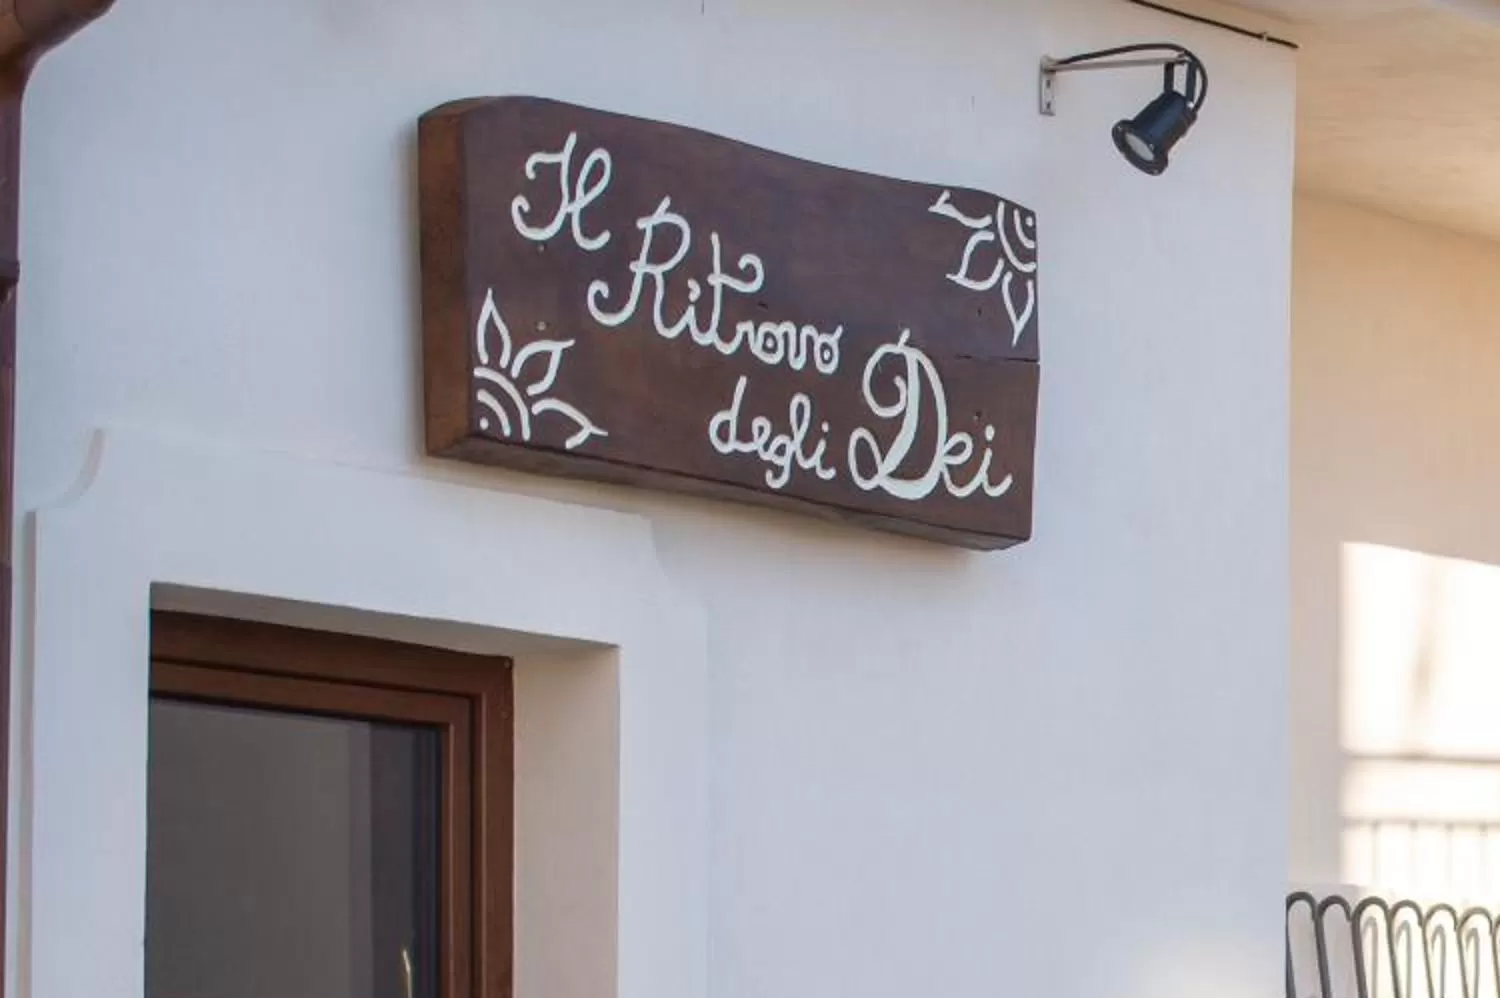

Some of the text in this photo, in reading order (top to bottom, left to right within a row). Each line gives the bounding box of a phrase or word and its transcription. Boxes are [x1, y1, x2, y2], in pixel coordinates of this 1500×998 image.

[511, 131, 612, 251] Il
[587, 195, 844, 375] Ritrovo
[708, 328, 1013, 501] degli Dei
